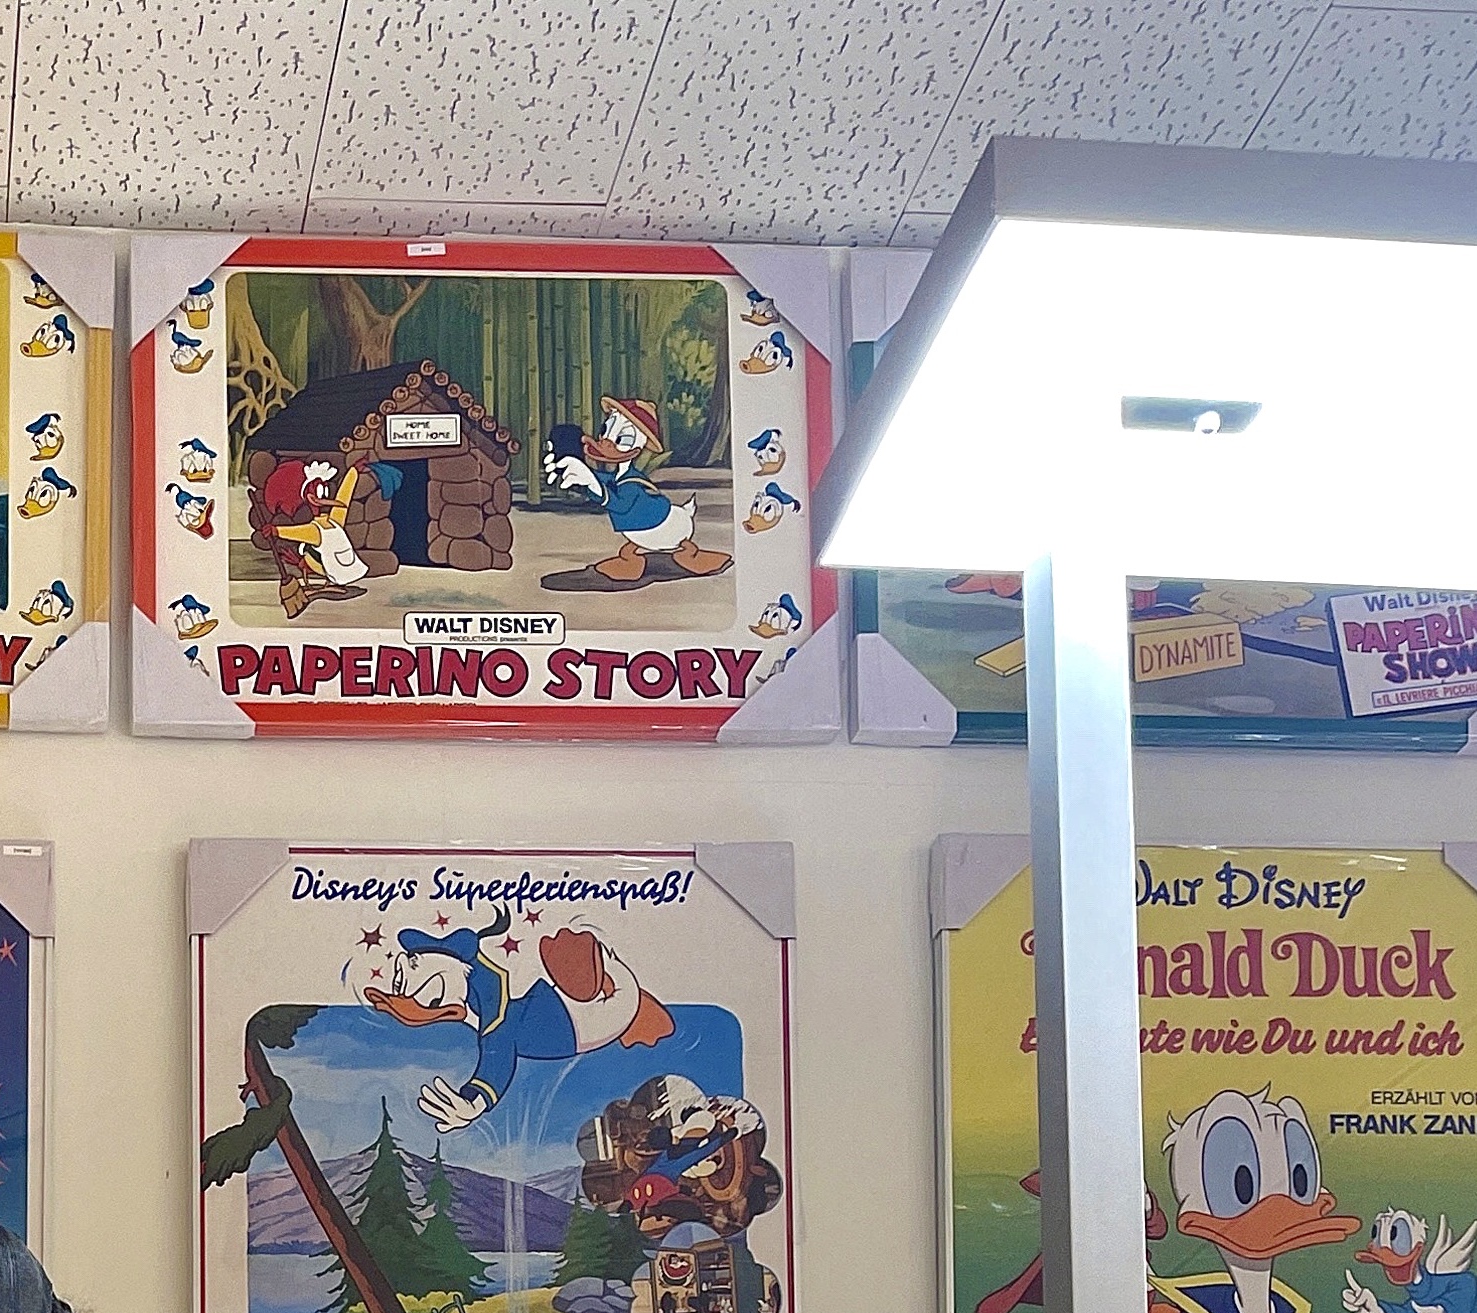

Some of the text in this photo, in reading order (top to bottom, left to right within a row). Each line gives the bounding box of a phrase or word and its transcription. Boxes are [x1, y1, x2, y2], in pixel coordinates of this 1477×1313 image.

[1363, 593, 1414, 612] Walt
[414, 617, 558, 634] WALT DISNEY
[217, 644, 763, 700] PAPERINO STORY
[1139, 631, 1238, 675] DYNAMITE
[291, 866, 418, 912] Disney's
[1271, 928, 1458, 1000] Duck
[1190, 1018, 1258, 1054] wie
[1261, 1016, 1317, 1055] Du
[1324, 1019, 1406, 1056] und
[1408, 1019, 1465, 1057] ich
[1370, 1088, 1446, 1106] ERZÄHLT
[1329, 1114, 1476, 1135] FRANK ZAN
